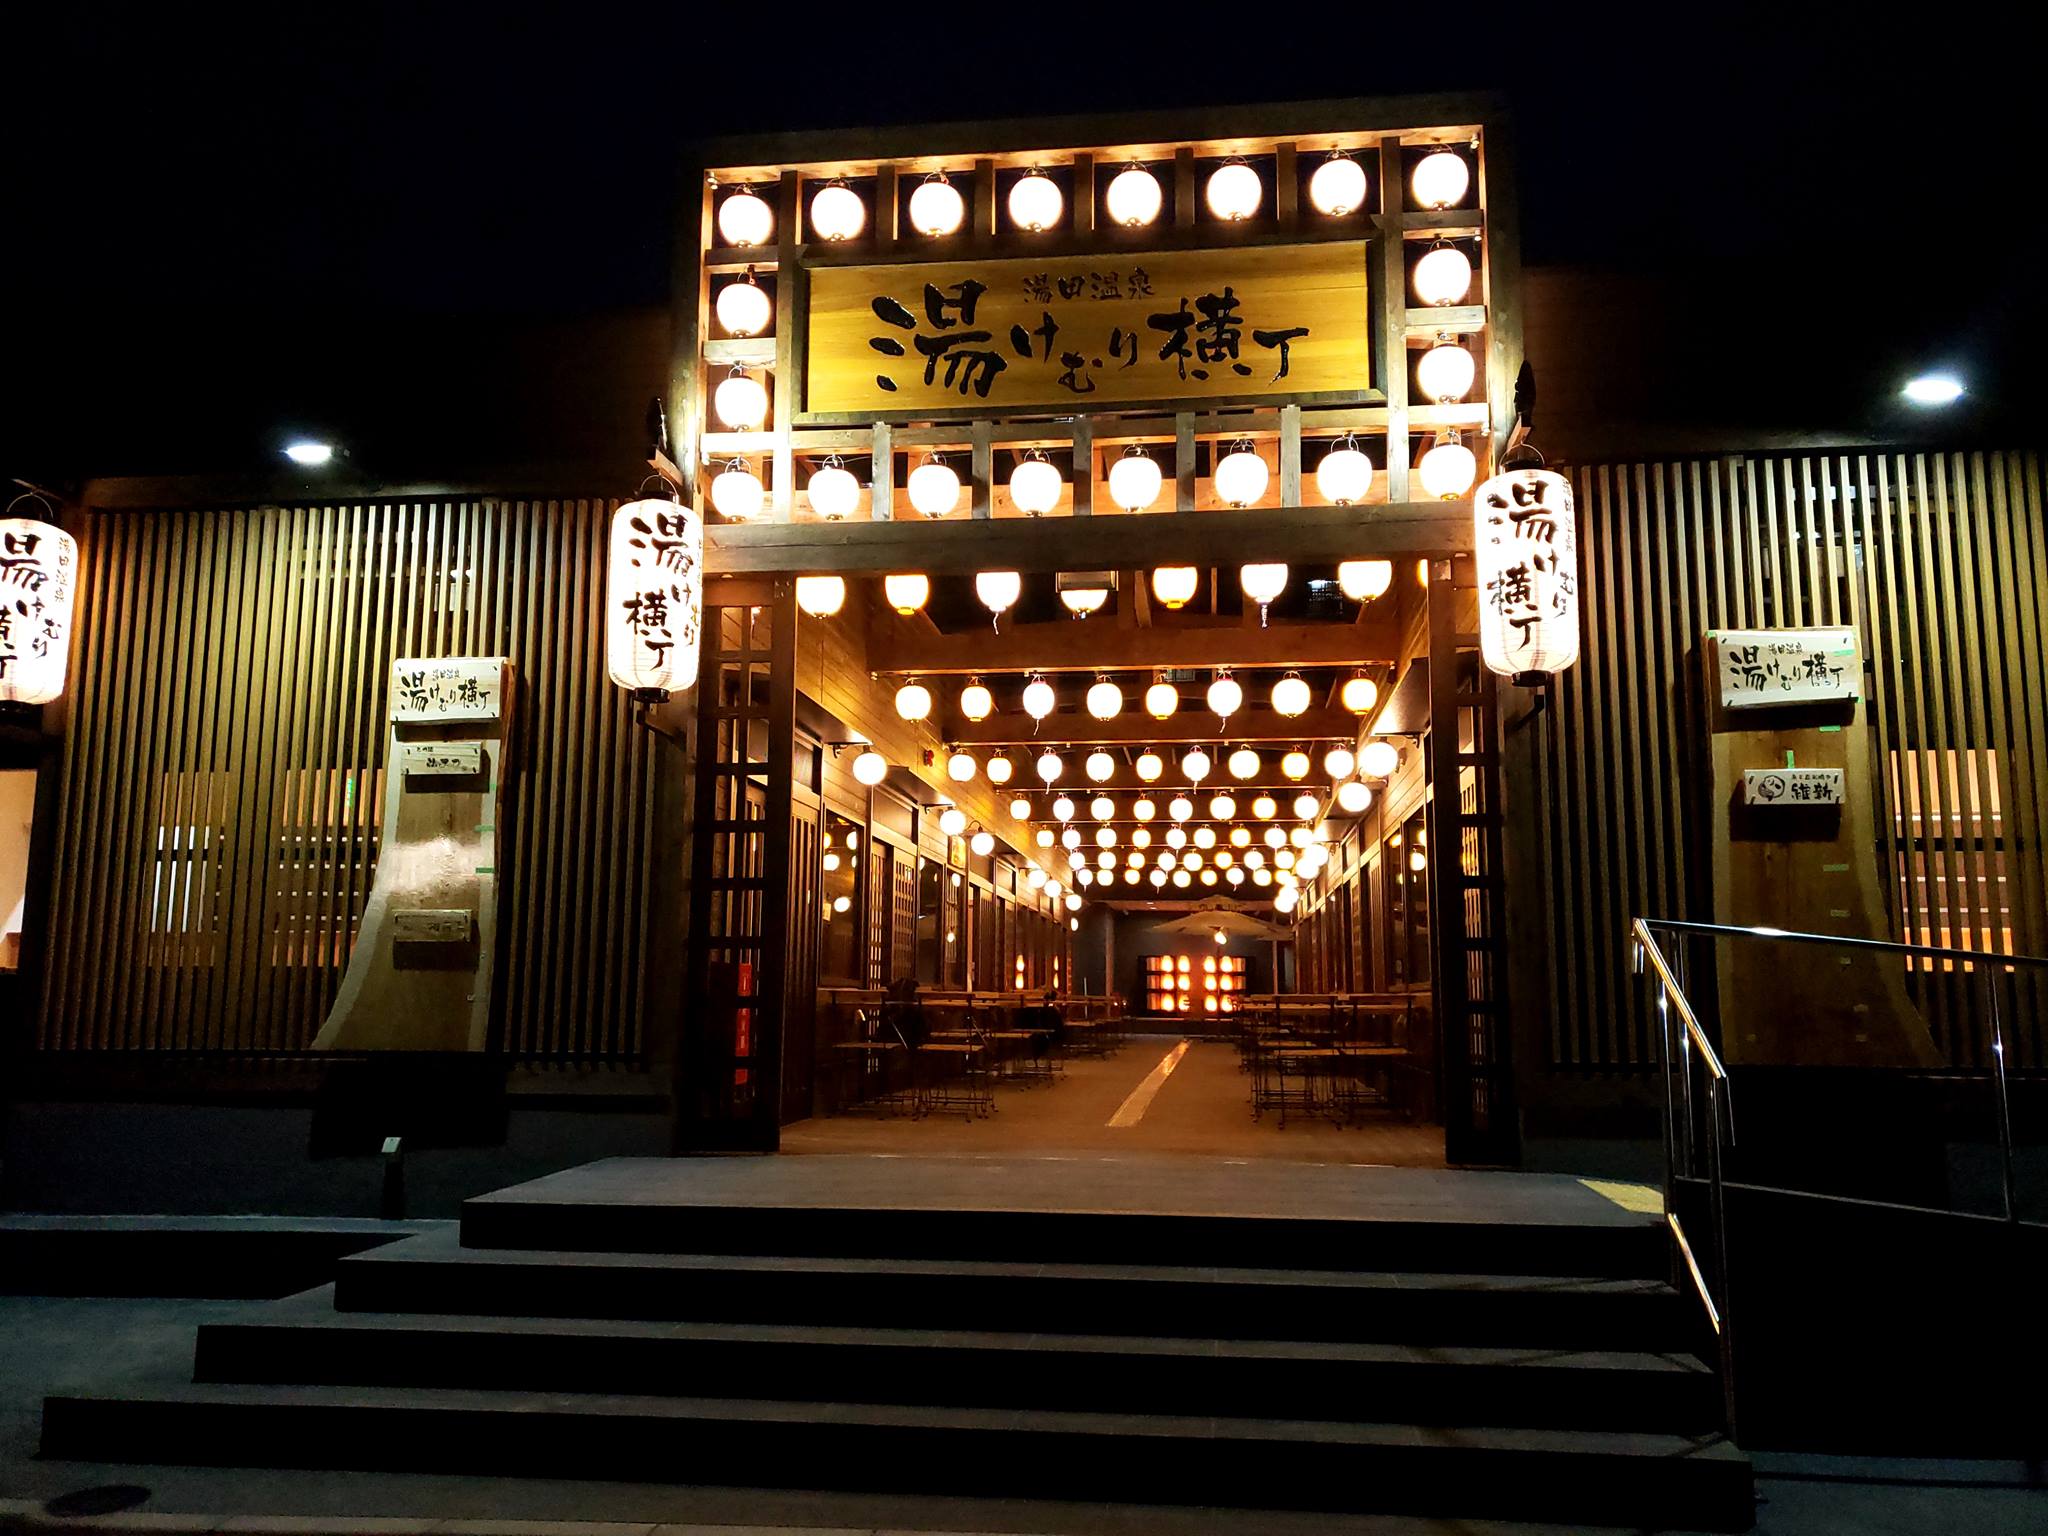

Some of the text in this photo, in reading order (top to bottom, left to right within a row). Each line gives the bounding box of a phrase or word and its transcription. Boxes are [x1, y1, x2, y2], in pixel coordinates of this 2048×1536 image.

[1022, 266, 1155, 304] 湯田温泉
[869, 279, 1309, 398] 湯けむり横丁
[1729, 645, 1844, 692] 湯けむり横丁
[400, 670, 491, 713] 湯けむり横丁
[1791, 782, 1834, 801] 維新
